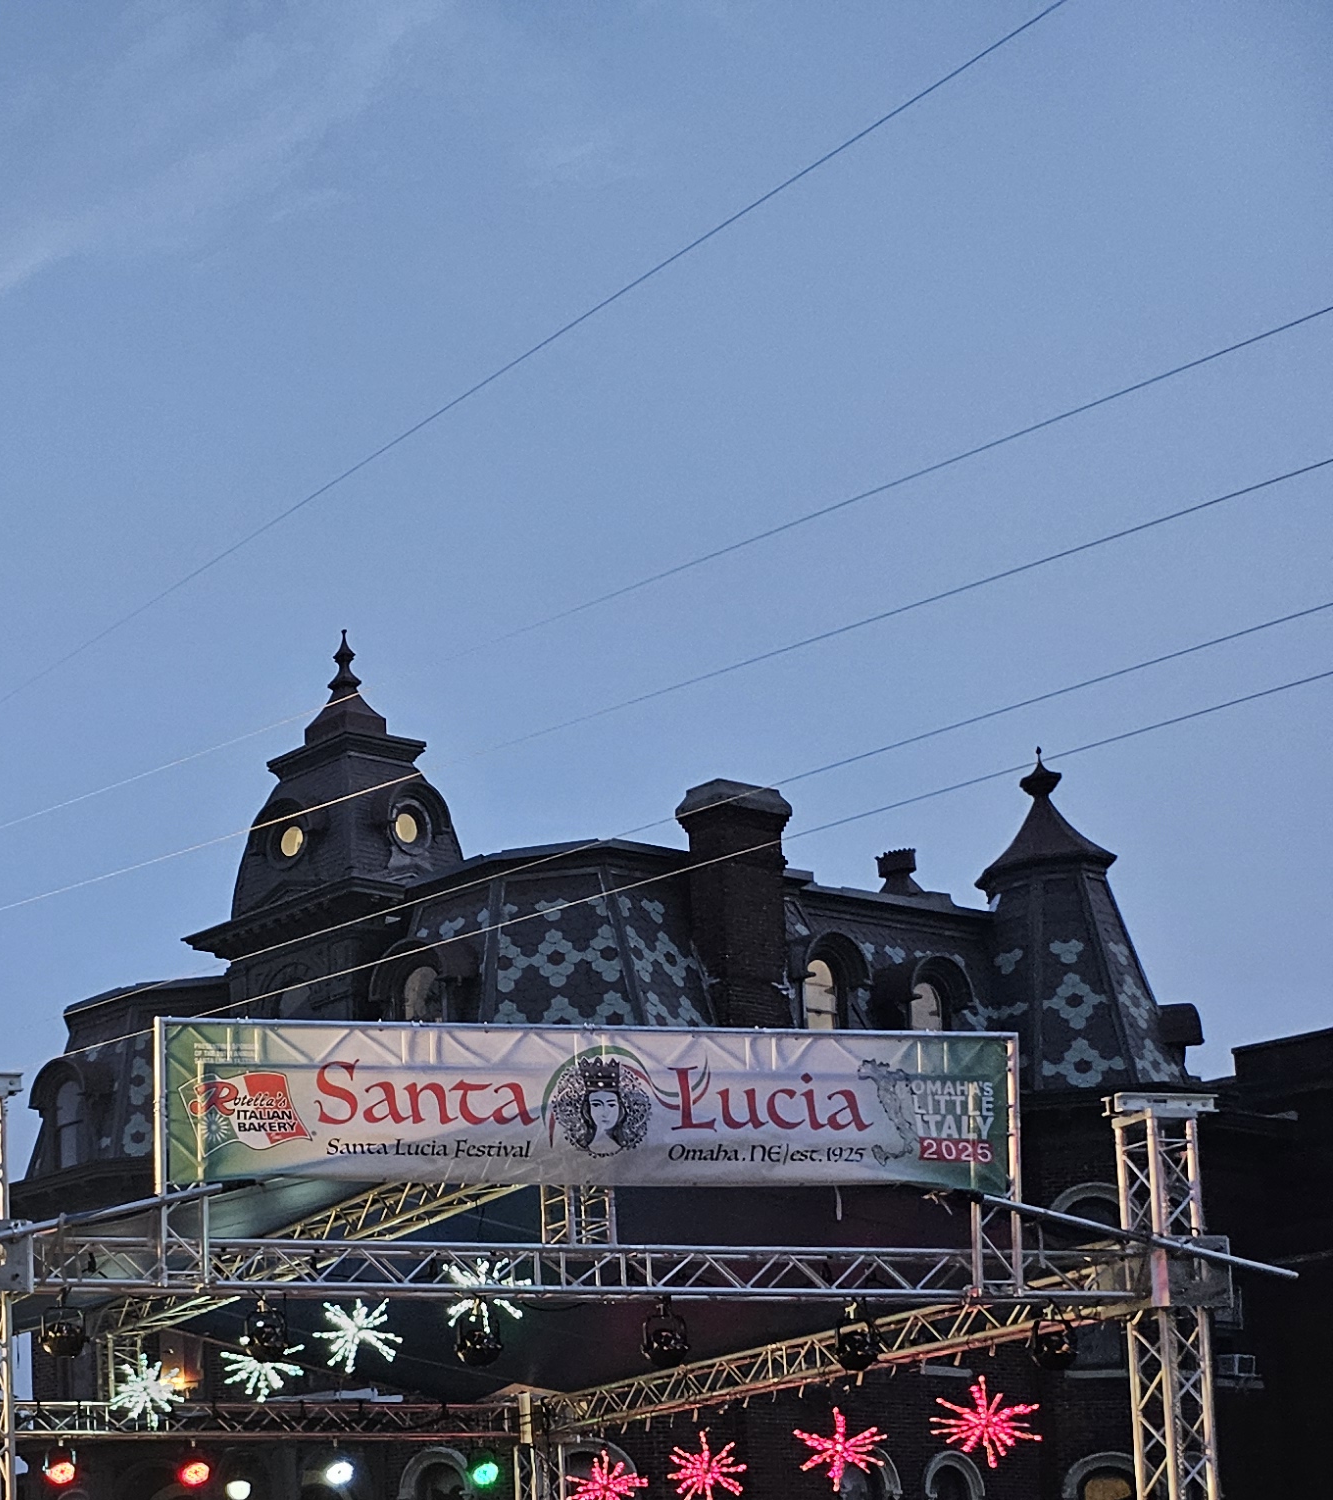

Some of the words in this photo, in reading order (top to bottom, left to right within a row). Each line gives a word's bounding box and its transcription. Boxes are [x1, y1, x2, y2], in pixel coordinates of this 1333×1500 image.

[190, 1081, 287, 1116] Rotella's
[314, 1059, 540, 1127] Santa
[668, 1065, 875, 1132] Lucia
[911, 1080, 994, 1096] OMAHA'S
[236, 1110, 292, 1120] ITALIAN
[913, 1095, 995, 1116] LITTLE
[238, 1122, 297, 1132] BAKERY
[914, 1114, 995, 1140] ITALY
[326, 1138, 389, 1156] Santa
[393, 1138, 449, 1157] Lucia
[452, 1138, 531, 1159] Festival
[826, 1146, 866, 1163] 1925
[922, 1139, 993, 1162] 2025
